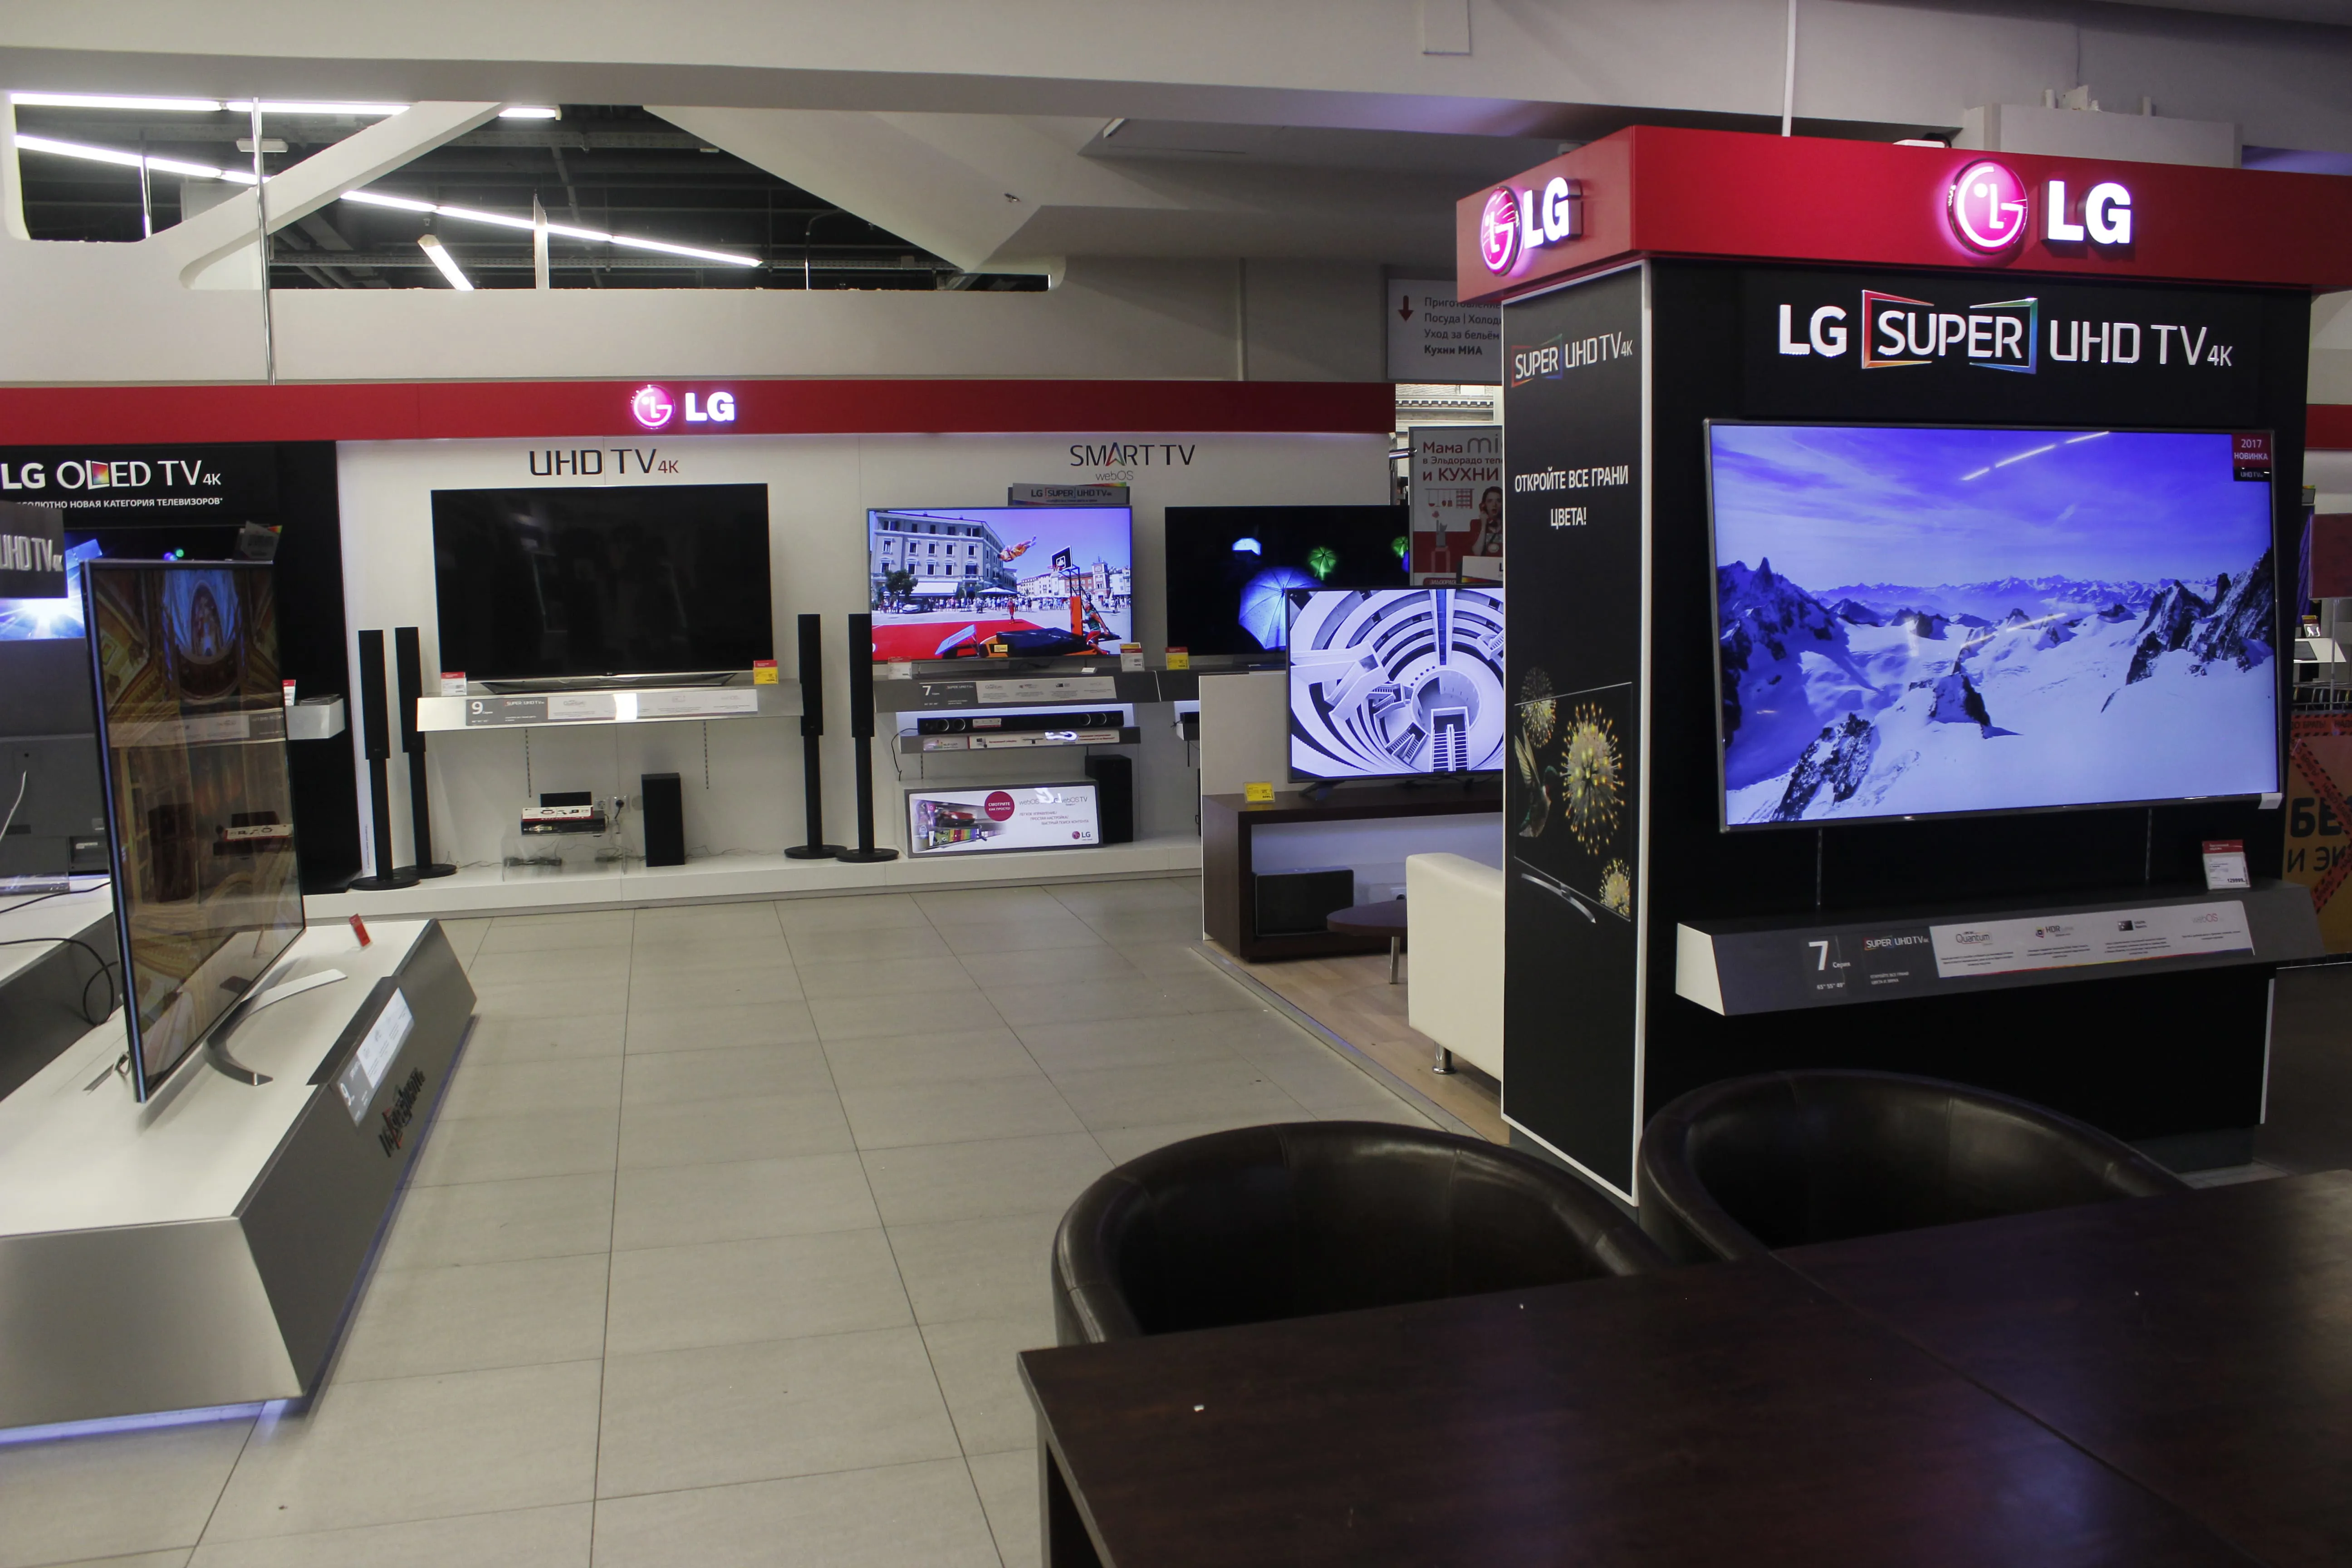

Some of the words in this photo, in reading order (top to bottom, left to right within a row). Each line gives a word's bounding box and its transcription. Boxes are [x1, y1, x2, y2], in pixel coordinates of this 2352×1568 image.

[1523, 176, 1570, 249] LG
[2048, 180, 2132, 245] LG
[1425, 313, 1460, 325] Посуда
[1424, 328, 1448, 339] Уход
[1465, 330, 1499, 339] бельём
[1779, 304, 1847, 357] LG
[1878, 309, 2023, 359] SUPER
[2050, 319, 2141, 364] UHD
[1424, 345, 1455, 356] Кухни
[1458, 346, 1482, 355] МИА
[1515, 345, 1558, 380] SUPER
[1565, 338, 1598, 369] UHD
[685, 392, 735, 422] LG
[1423, 441, 1463, 453] Мама
[1467, 434, 1502, 453] mi
[2241, 439, 2262, 448] 2017
[1070, 442, 1155, 467] SMART
[1159, 444, 1196, 466] TV
[1431, 456, 1482, 466] Эльдорадо
[2234, 452, 2268, 461] НОВИНКА
[529, 449, 603, 476] UHD
[1, 463, 45, 489] LG
[56, 460, 151, 490] OLED
[1095, 470, 1133, 481] webOS
[1423, 471, 1432, 481] и
[1439, 467, 1498, 481] КУХНИ
[1515, 466, 1566, 492] ОТКРОЙТЕ
[1568, 469, 1588, 489] ВСЕ
[1592, 465, 1629, 487] ГРАНИ
[104, 499, 155, 508] КАТЕГОРИЯ
[1551, 507, 1587, 529] ЦВЕТА!
[922, 686, 931, 696] 7
[472, 701, 483, 715] 9
[2288, 848, 2305, 873] И
[2192, 913, 2219, 924] webOS
[1866, 938, 1892, 948] SUPER
[1895, 936, 1912, 946] UHD
[1955, 933, 1990, 944] Quantum
[1808, 941, 1828, 970] 7
